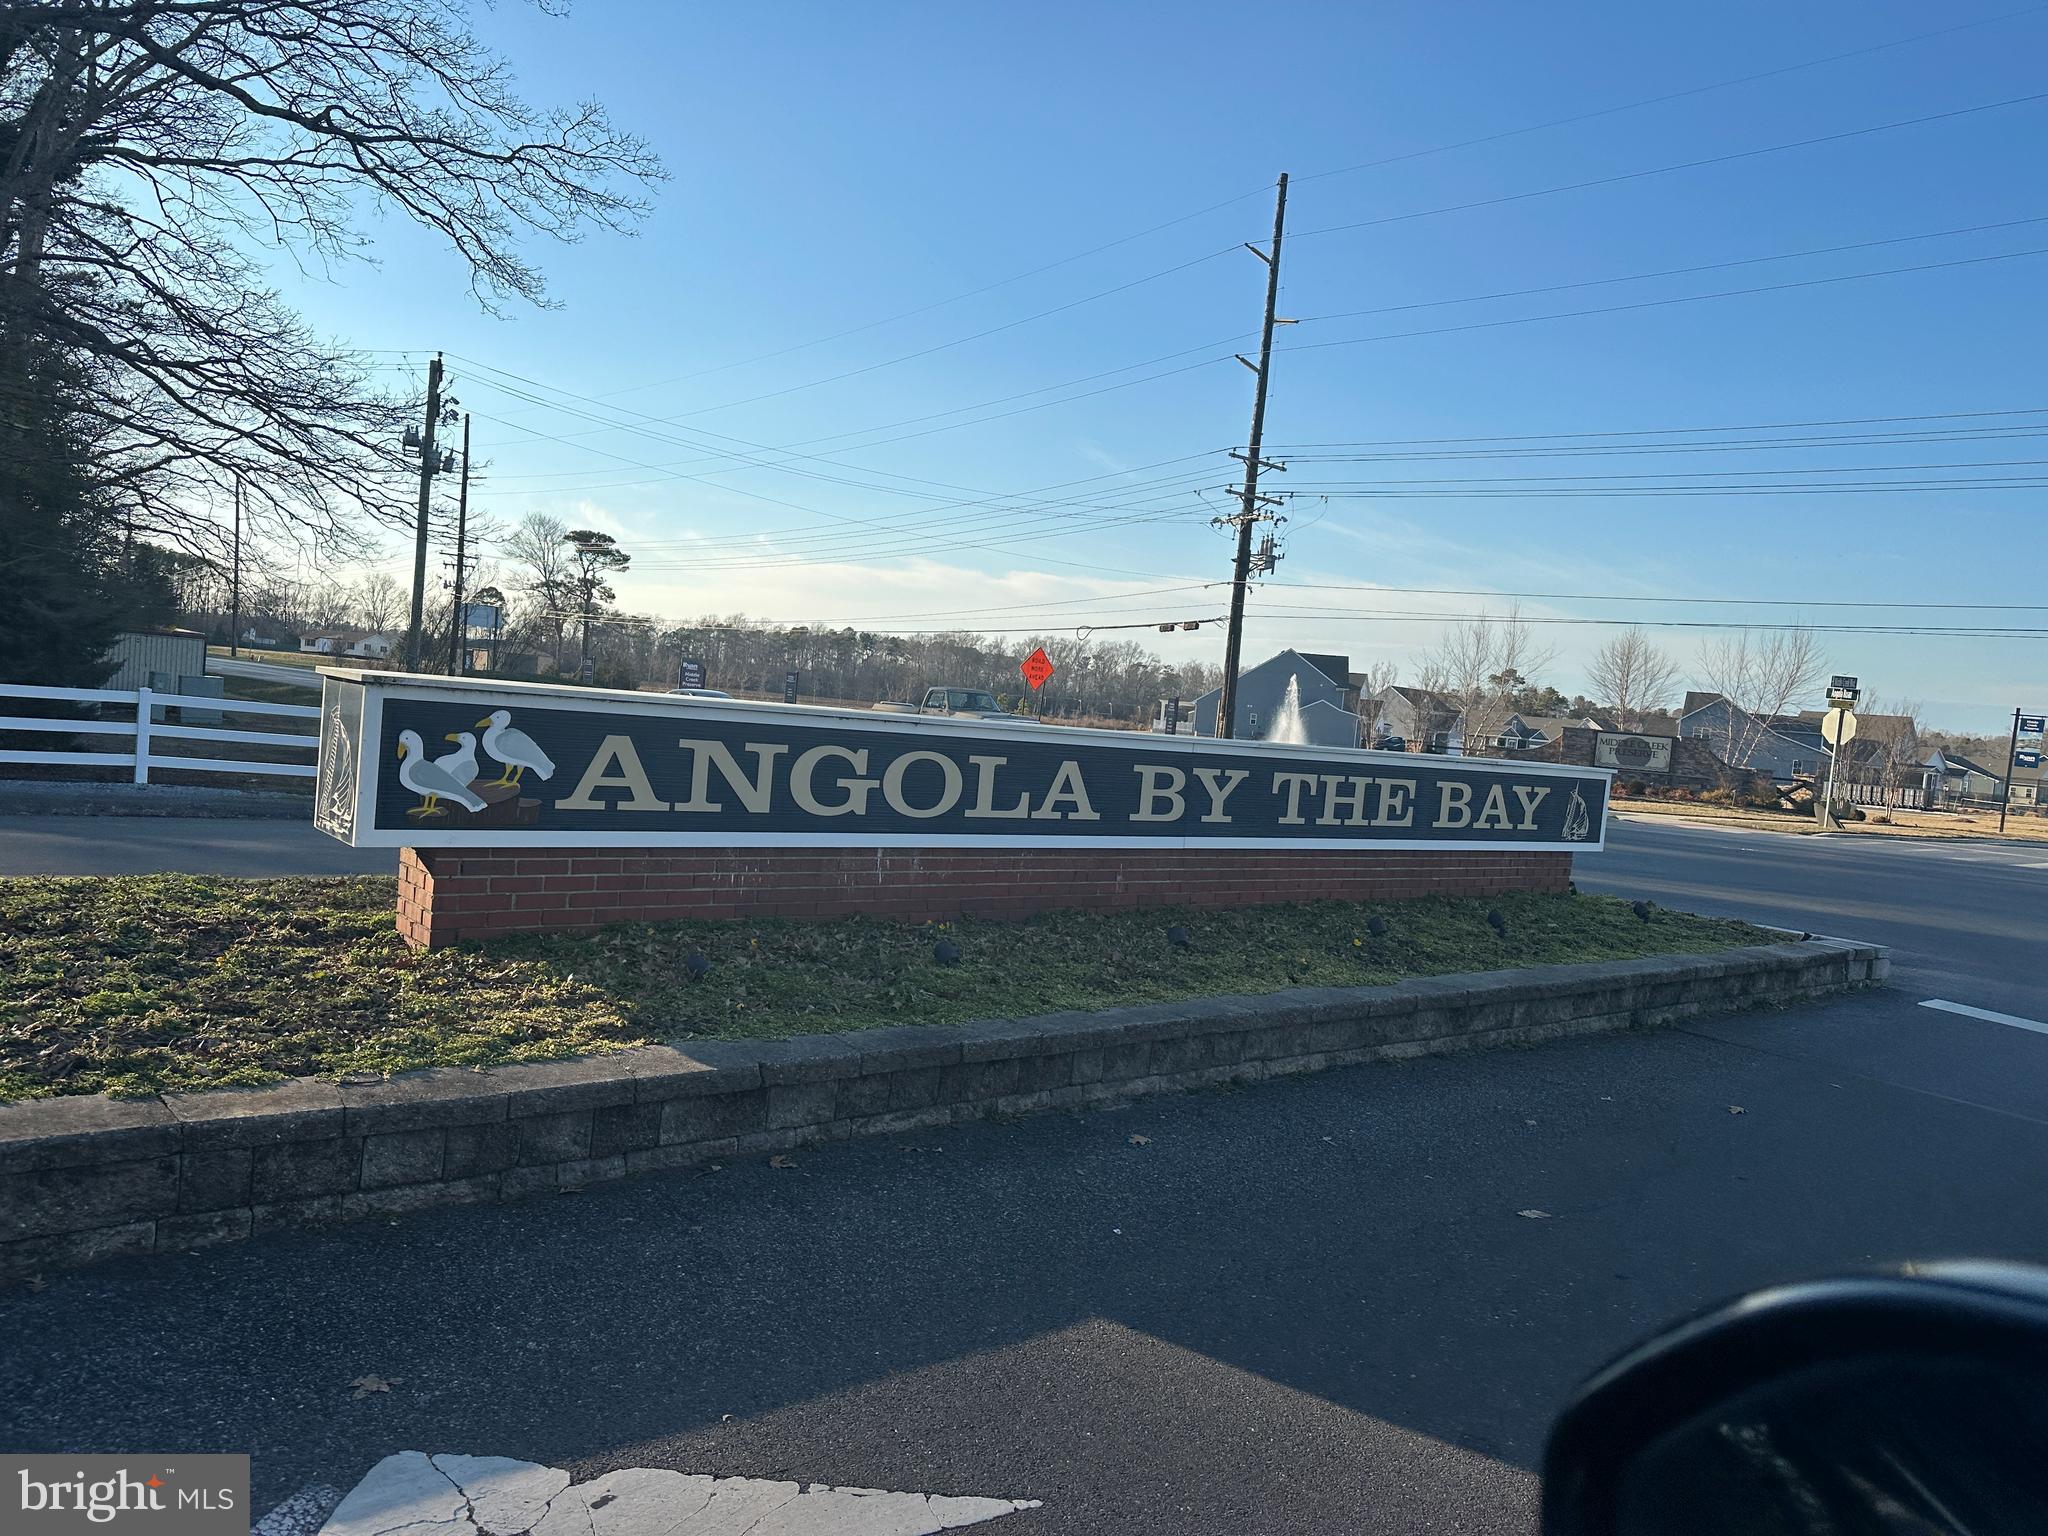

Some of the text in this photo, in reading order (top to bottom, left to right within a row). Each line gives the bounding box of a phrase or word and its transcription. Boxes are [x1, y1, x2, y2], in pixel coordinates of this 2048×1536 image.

[555, 735, 1550, 829] ANGOLA BY THE BAY
